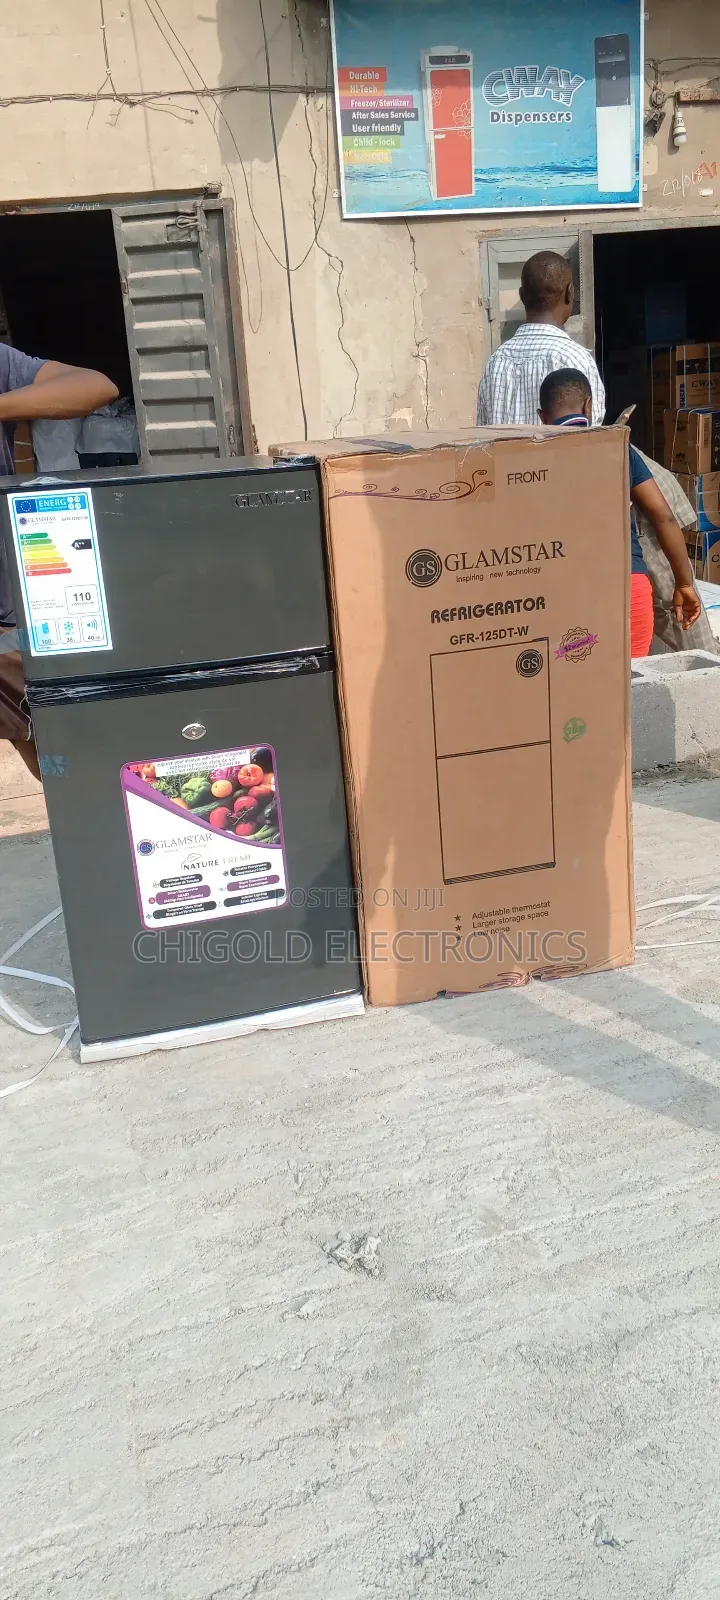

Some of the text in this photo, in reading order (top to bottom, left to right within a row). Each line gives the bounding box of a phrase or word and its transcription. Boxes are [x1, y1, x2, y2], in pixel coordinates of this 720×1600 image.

[349, 71, 380, 80] Durable
[350, 85, 378, 94] Hi-Tech
[482, 65, 586, 107] CWAY
[351, 110, 416, 120] After Sales Service
[489, 110, 572, 127] Dispensers
[352, 123, 402, 134] User friendly
[353, 137, 373, 147] Child
[507, 469, 548, 485] FRONT
[39, 499, 67, 507] ENERG
[412, 540, 567, 577] GS GLAMSTAR
[456, 566, 542, 583] inspiring new technology
[73, 592, 91, 602] 110
[430, 596, 546, 624] REFRIGERATOR
[450, 625, 529, 646] GFR-125DT-W
[521, 657, 538, 670] GS
[156, 833, 213, 849] GLAMSTAR
[183, 854, 251, 870] NATURE FRESH
[472, 900, 551, 920] Adjustable thermostat
[472, 911, 549, 928] Larger storage space
[490, 926, 510, 935] noise
